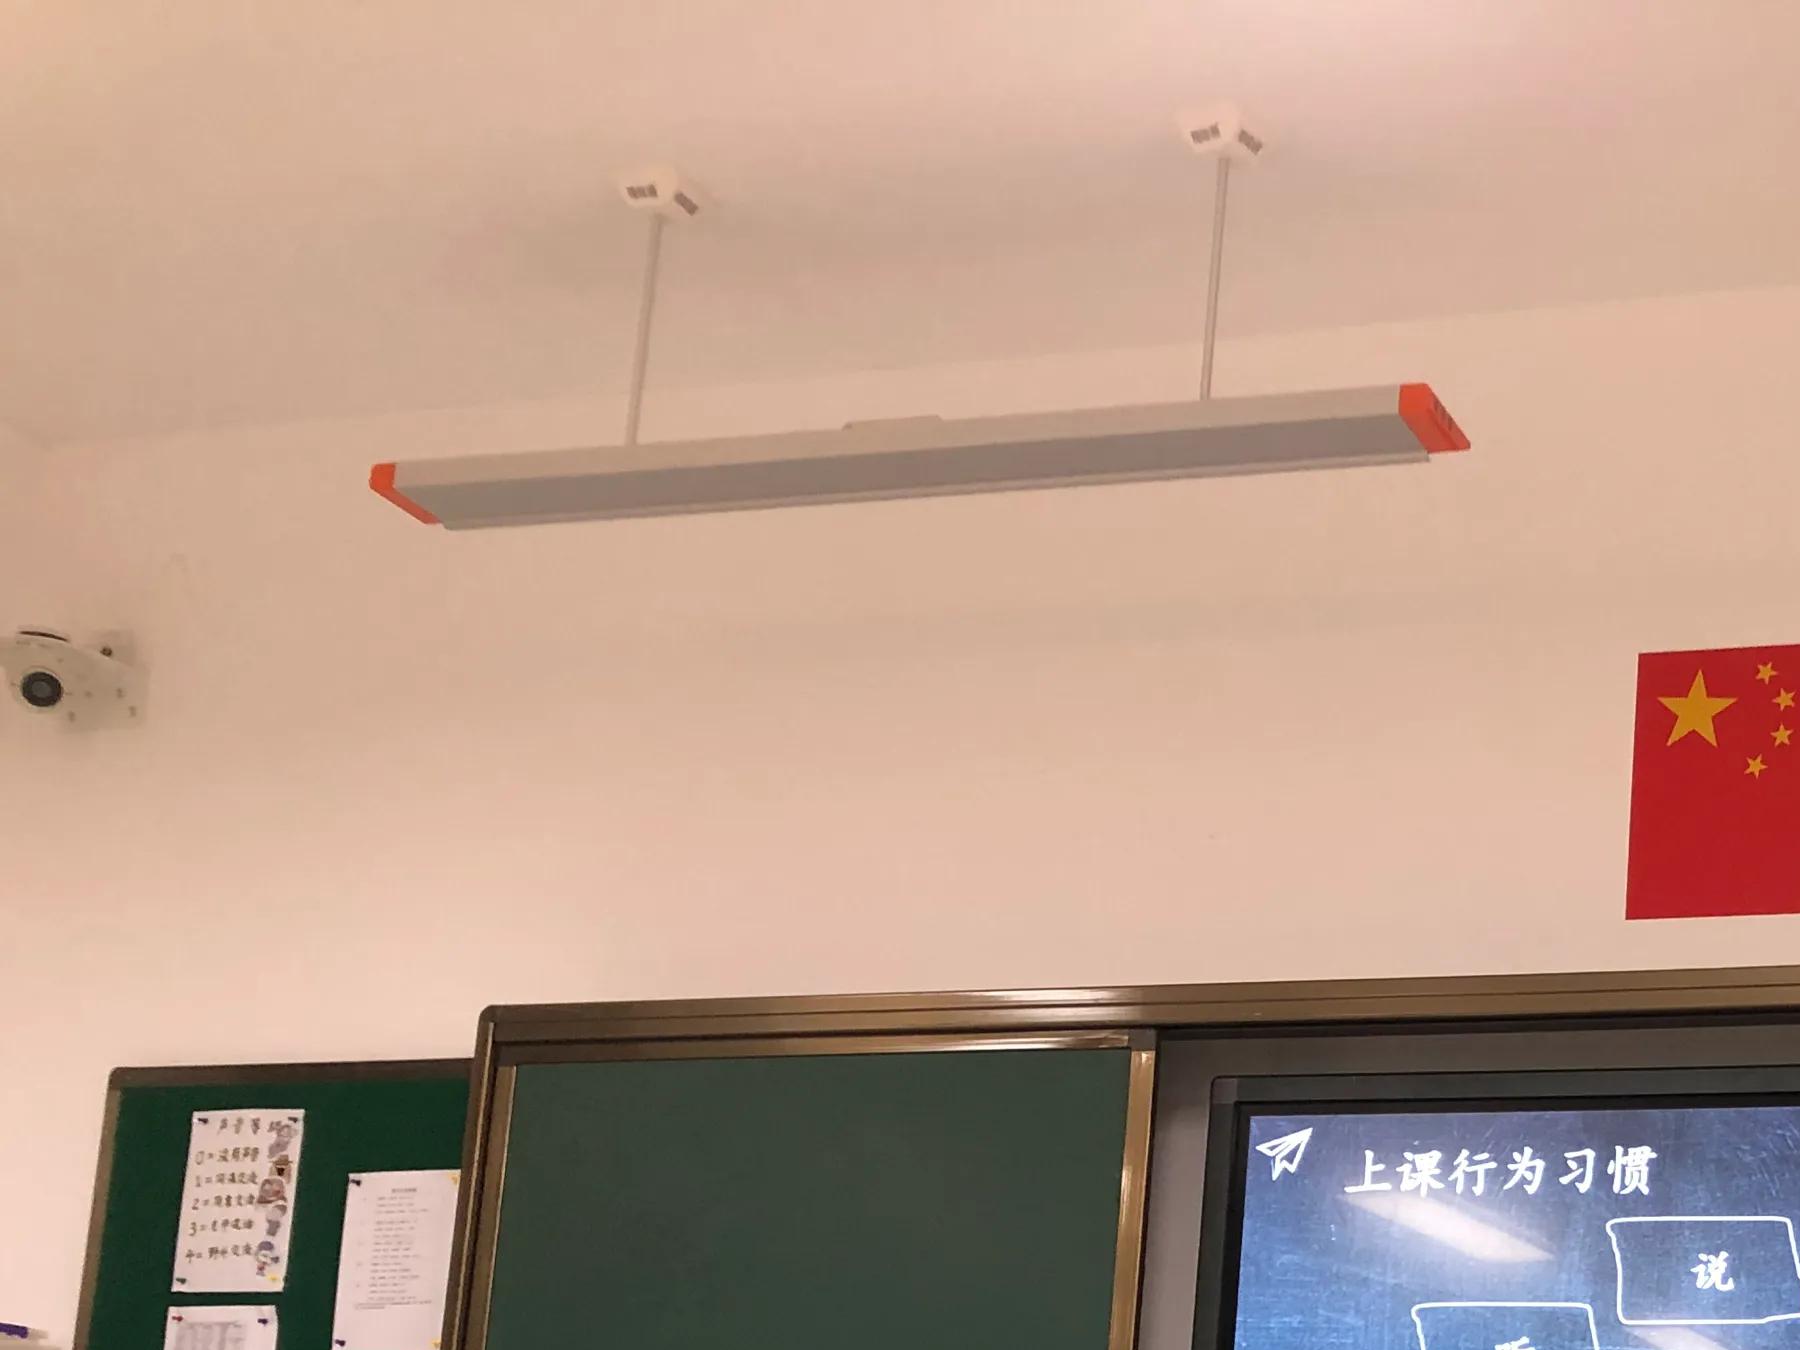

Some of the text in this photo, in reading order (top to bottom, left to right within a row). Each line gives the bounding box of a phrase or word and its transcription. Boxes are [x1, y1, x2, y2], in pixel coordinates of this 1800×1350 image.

[1344, 1146, 1657, 1197] 上课行为习惯
[1690, 1250, 1735, 1292] 说
